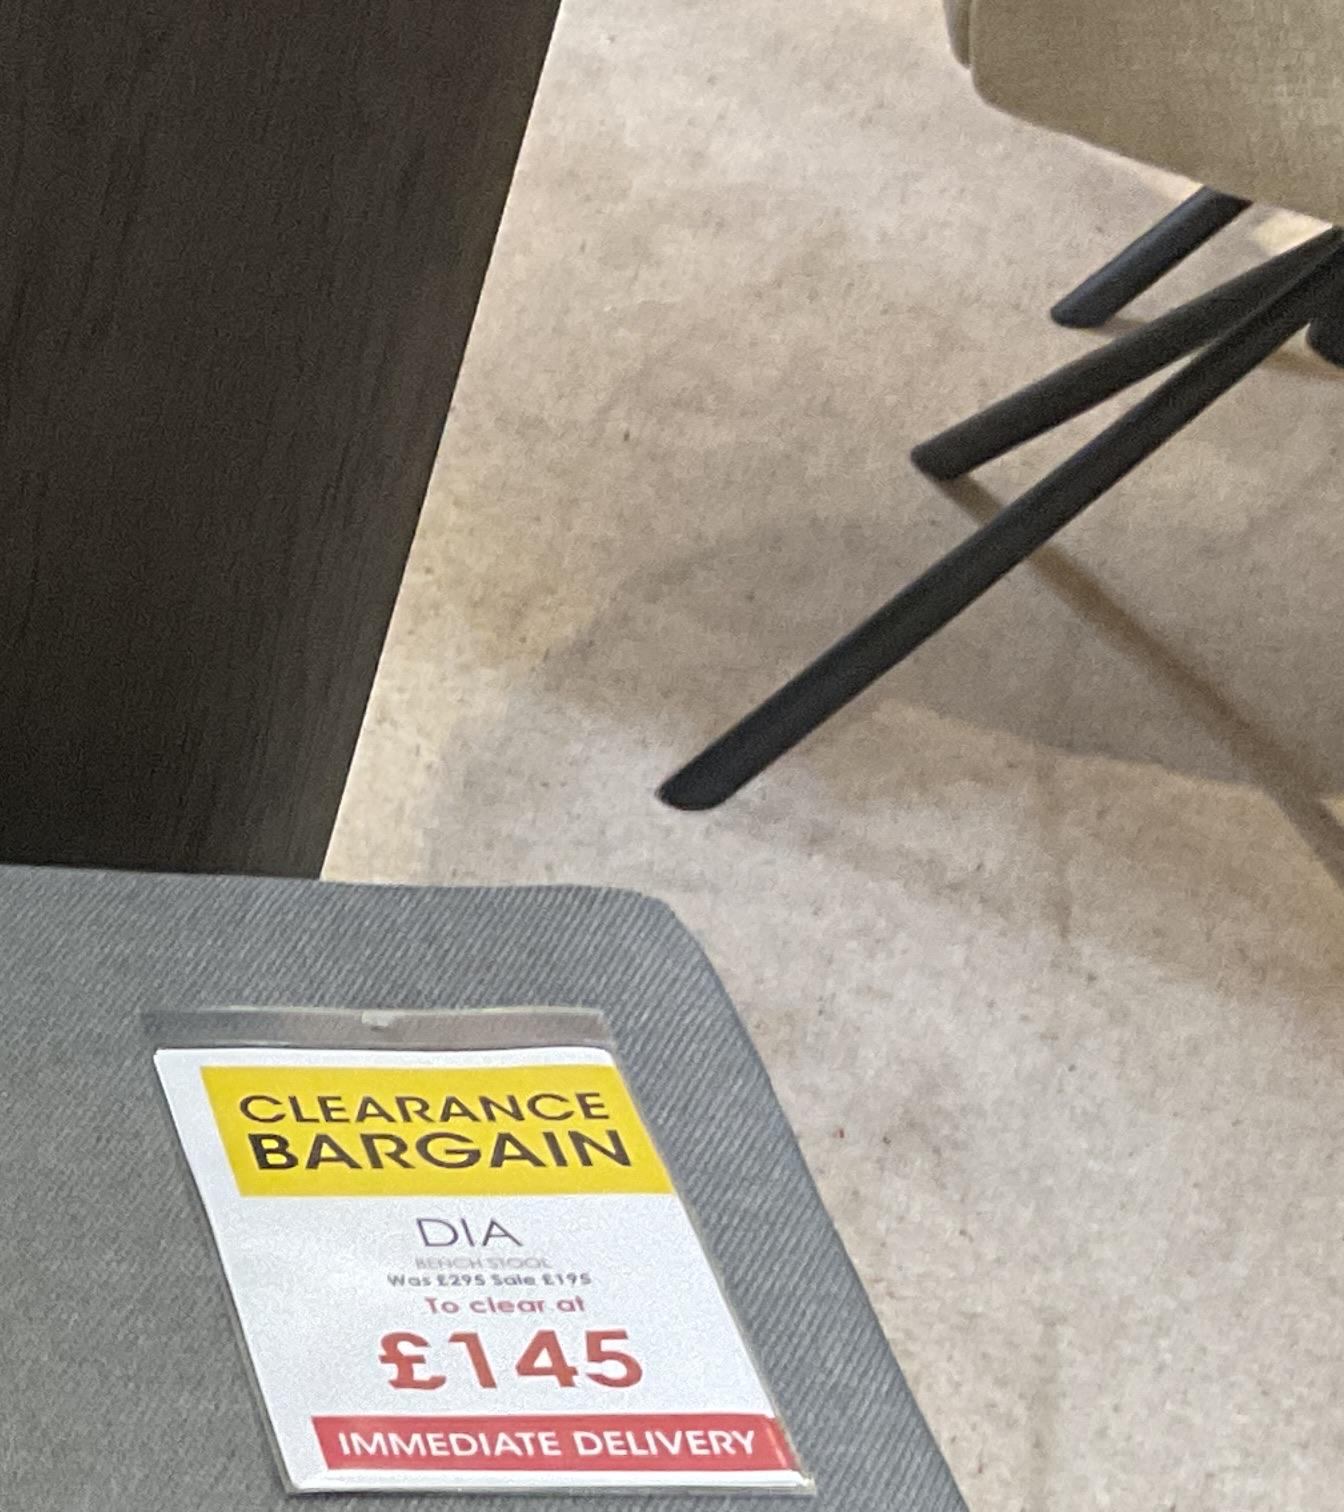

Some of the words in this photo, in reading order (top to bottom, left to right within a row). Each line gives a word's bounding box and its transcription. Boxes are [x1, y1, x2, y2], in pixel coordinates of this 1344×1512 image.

[239, 1091, 610, 1124] CLEARANCE
[248, 1128, 632, 1171] BARGAIN
[415, 1217, 523, 1248] DIA
[387, 1273, 432, 1287] Was
[436, 1273, 486, 1288] £295
[490, 1272, 538, 1287] Sale
[542, 1272, 592, 1287] £195
[424, 1296, 460, 1315] To
[470, 1296, 546, 1314] clear
[554, 1297, 586, 1314] at
[379, 1329, 643, 1390] £145
[339, 1430, 560, 1457] IMMEDIATE
[572, 1429, 756, 1457] DELIVERY
